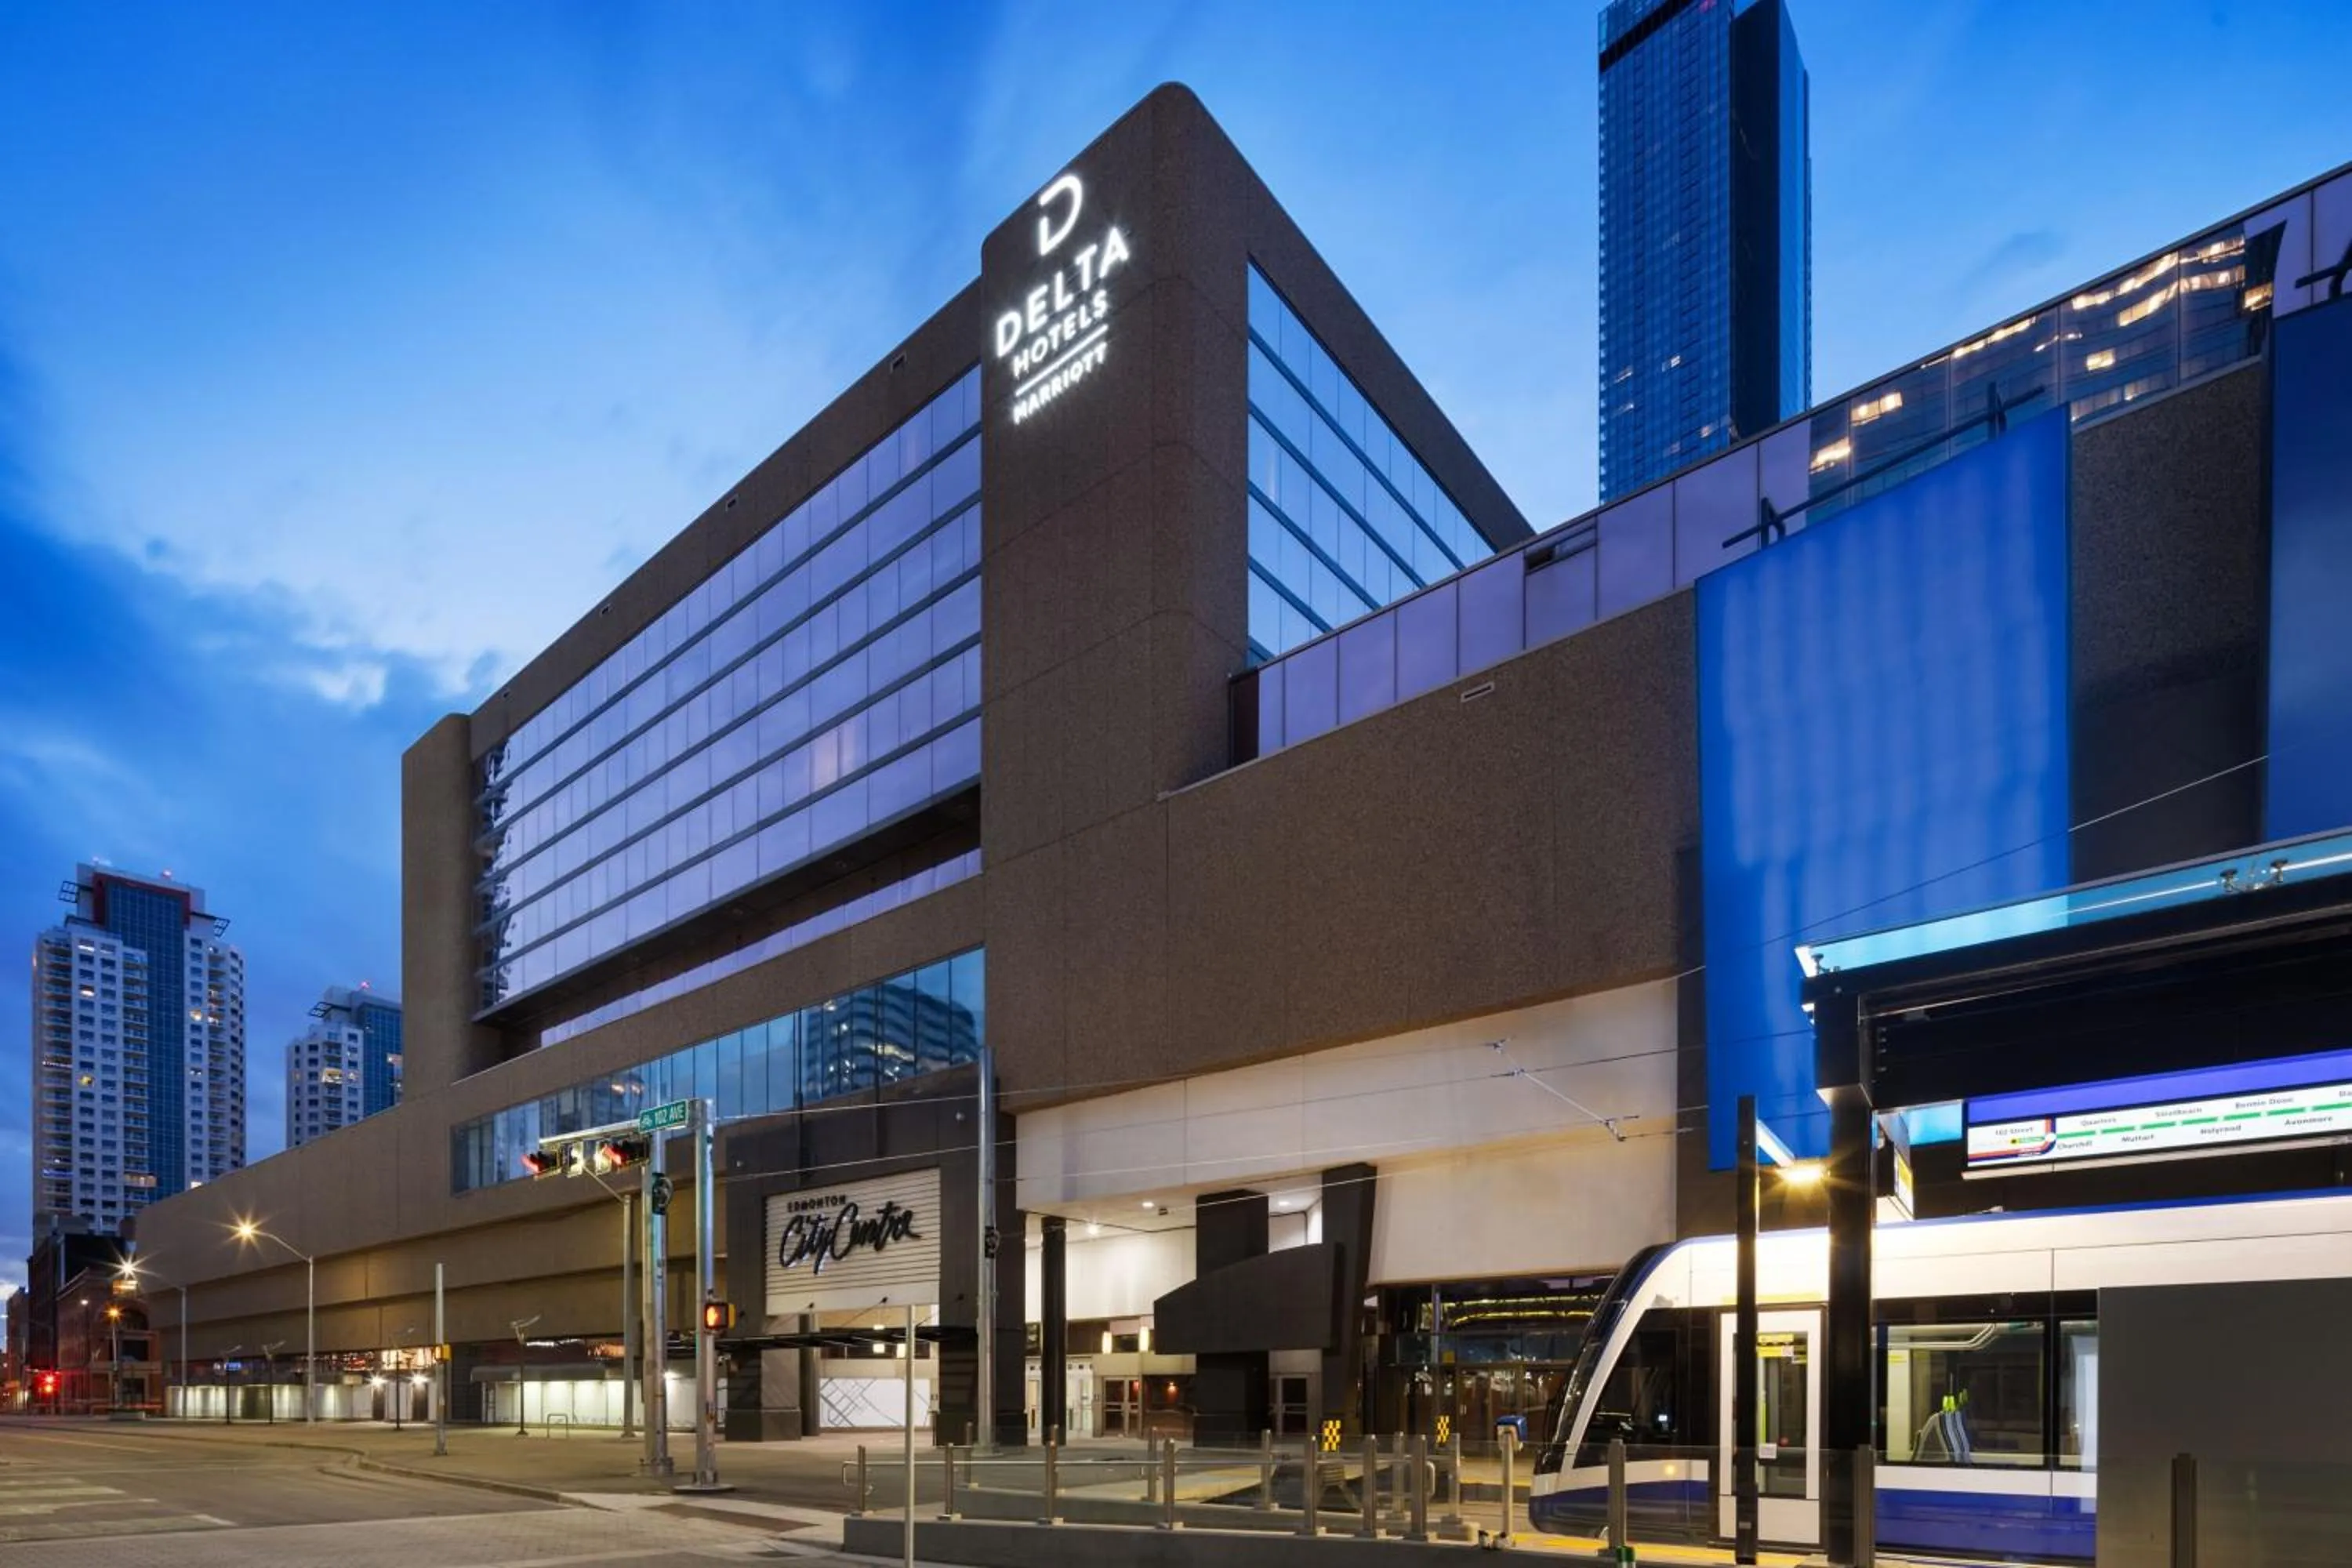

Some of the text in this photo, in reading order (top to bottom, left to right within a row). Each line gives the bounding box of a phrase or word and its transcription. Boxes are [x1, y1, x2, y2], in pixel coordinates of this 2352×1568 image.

[996, 226, 1130, 358] DELTA
[1012, 289, 1109, 379] HOTELS
[1012, 341, 1109, 426] MARRIOTT
[655, 1104, 684, 1124] 102 AVE
[786, 1194, 847, 1213] EDMONTON
